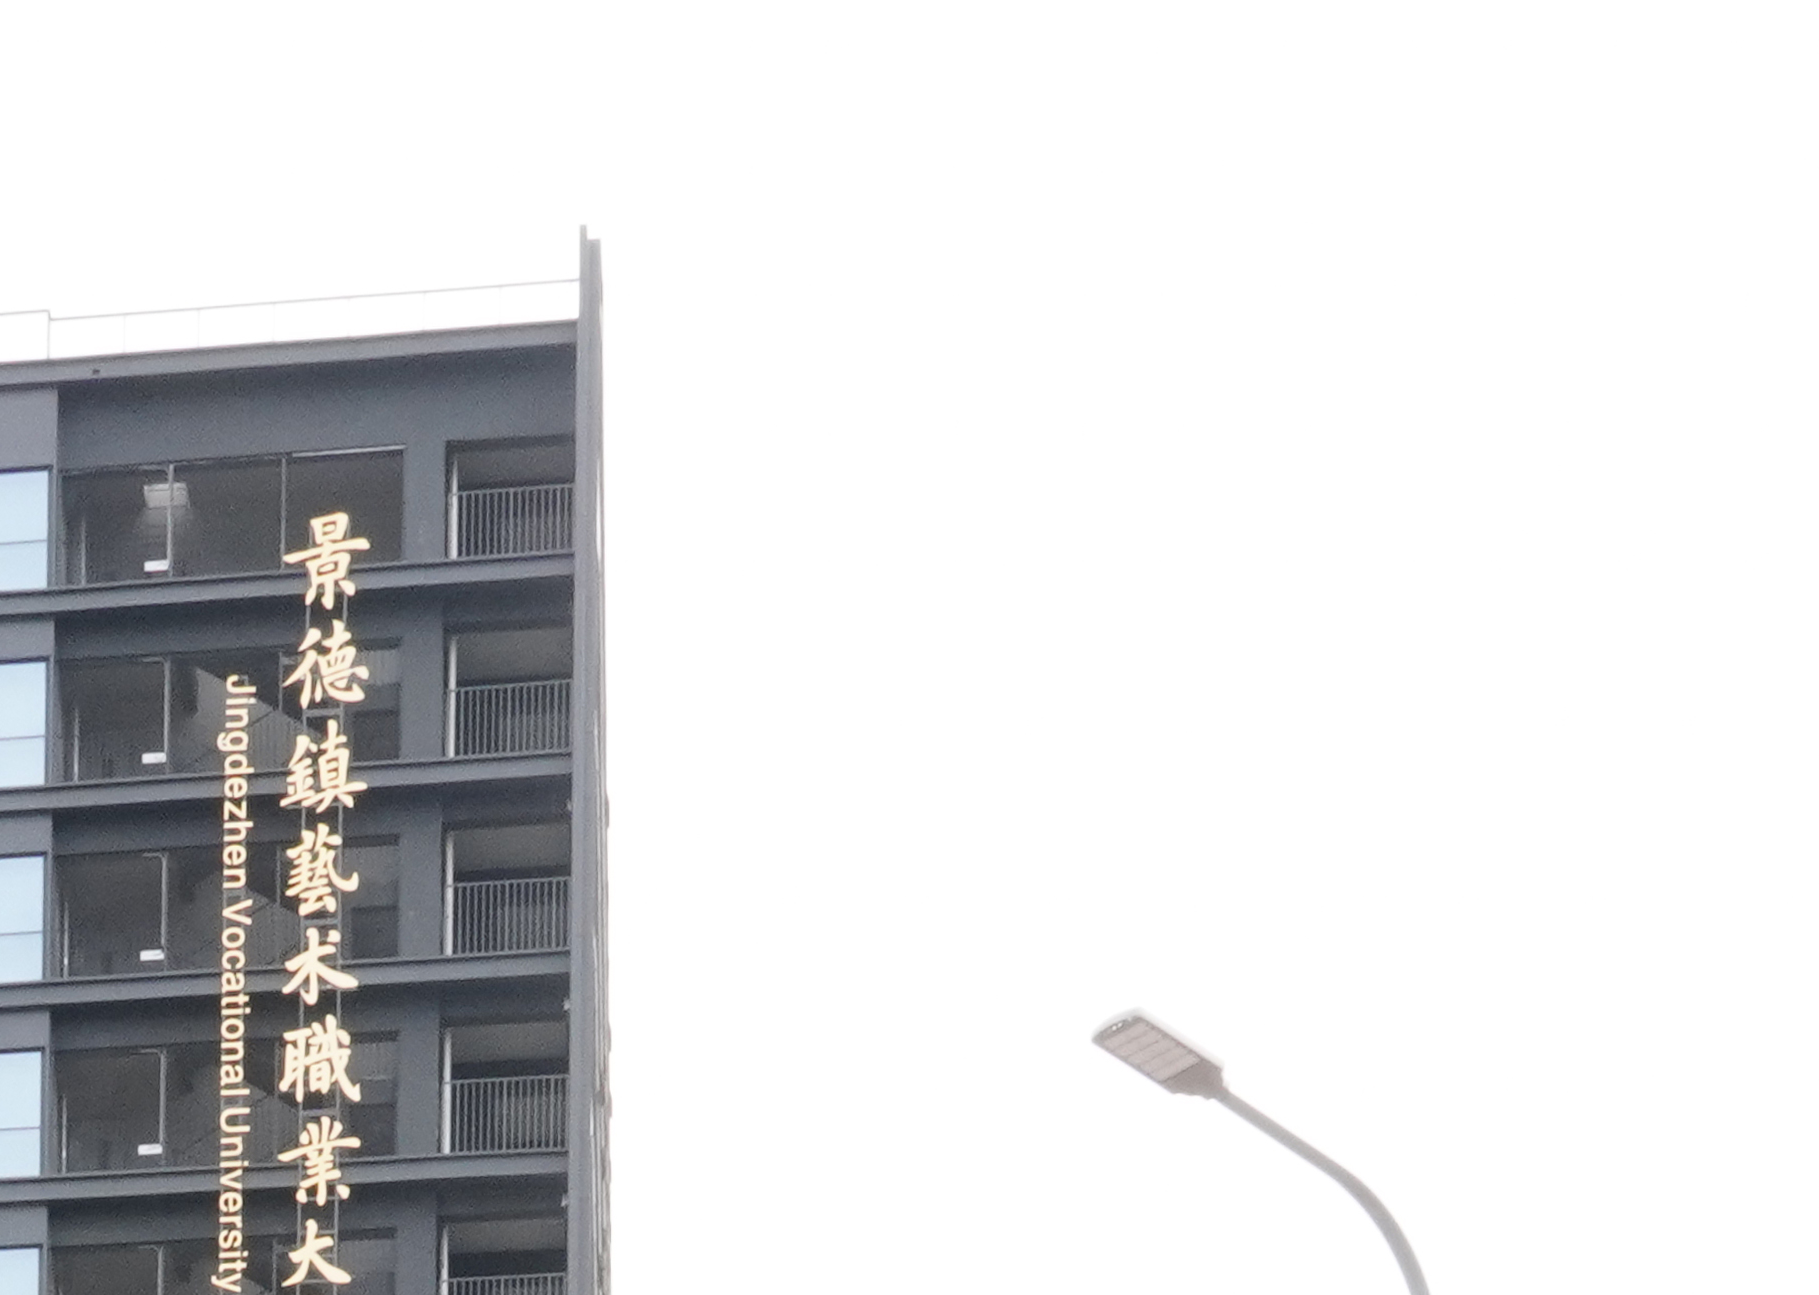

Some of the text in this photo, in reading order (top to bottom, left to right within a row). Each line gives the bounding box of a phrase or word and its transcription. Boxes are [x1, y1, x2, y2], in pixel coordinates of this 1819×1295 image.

[217, 673, 257, 890] Jingdezhen
[220, 899, 253, 1097] Vocational
[211, 1106, 251, 1293] University
